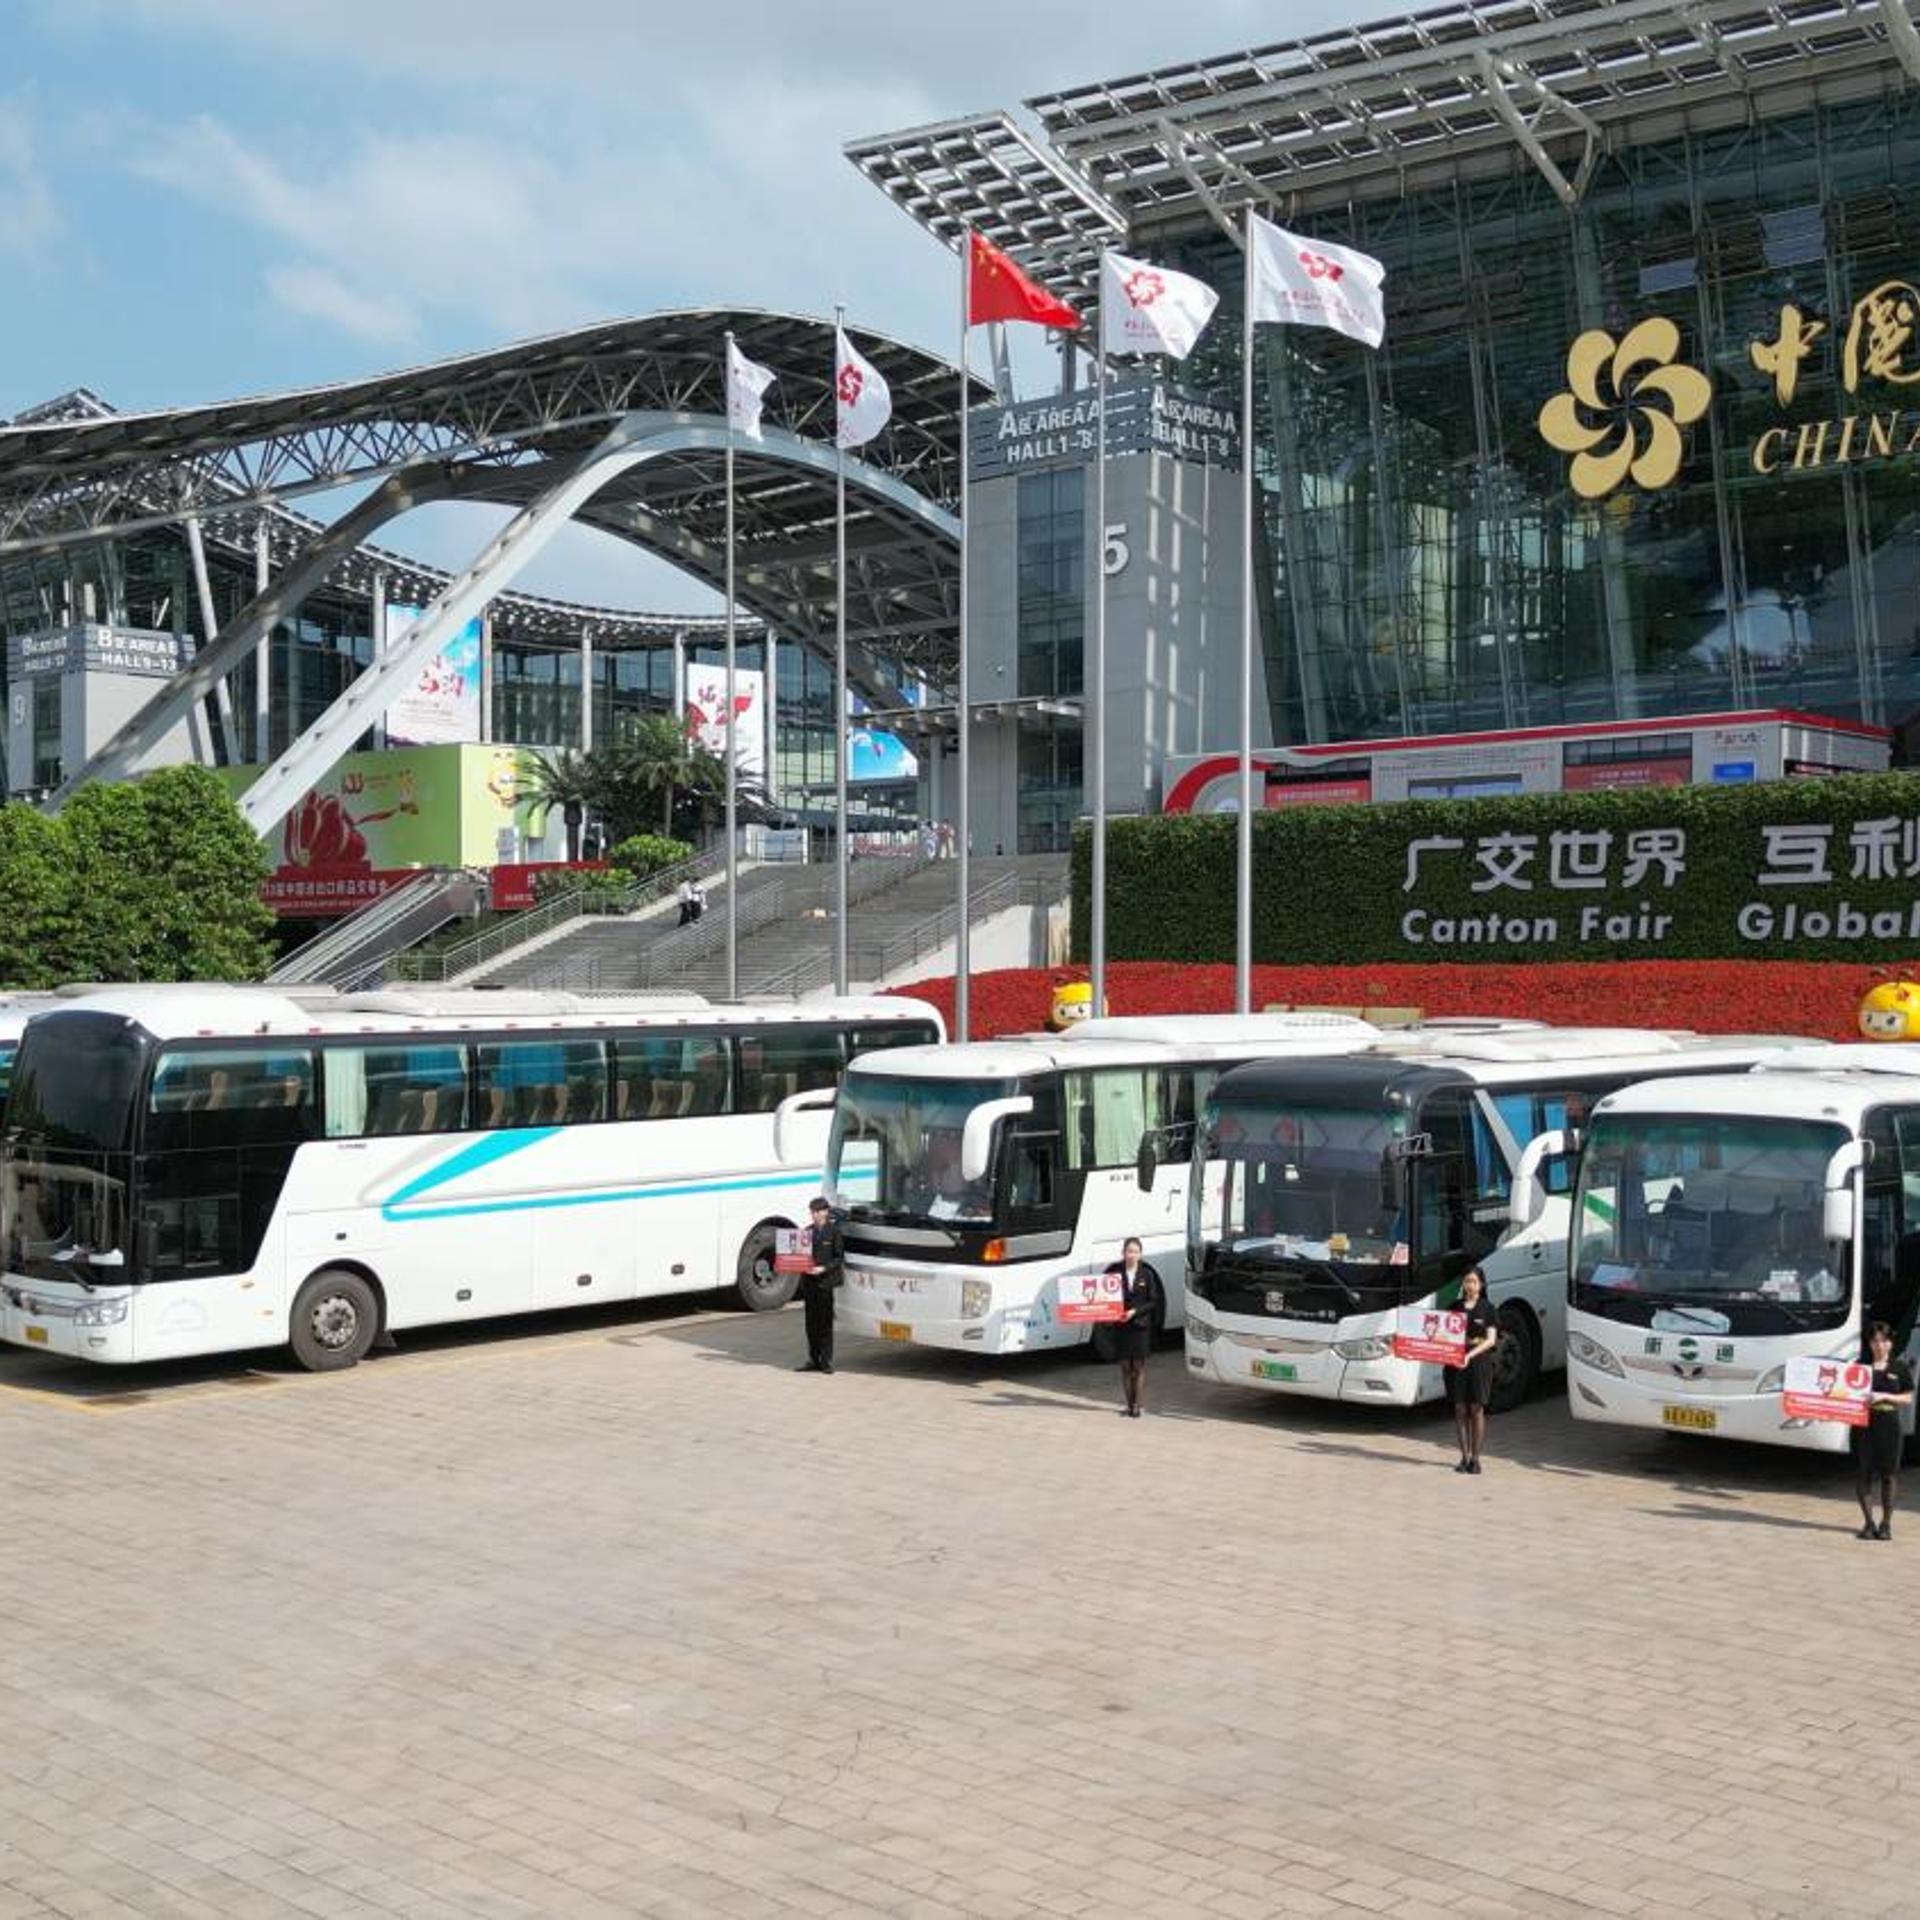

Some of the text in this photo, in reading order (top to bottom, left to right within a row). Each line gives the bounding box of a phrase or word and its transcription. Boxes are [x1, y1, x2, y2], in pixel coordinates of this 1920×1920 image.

[1036, 407, 1086, 433] AREA
[1102, 523, 1131, 576] 5
[1401, 815, 1920, 893] 广交世界 互利
[1402, 900, 1920, 943] Canton Fair Global
